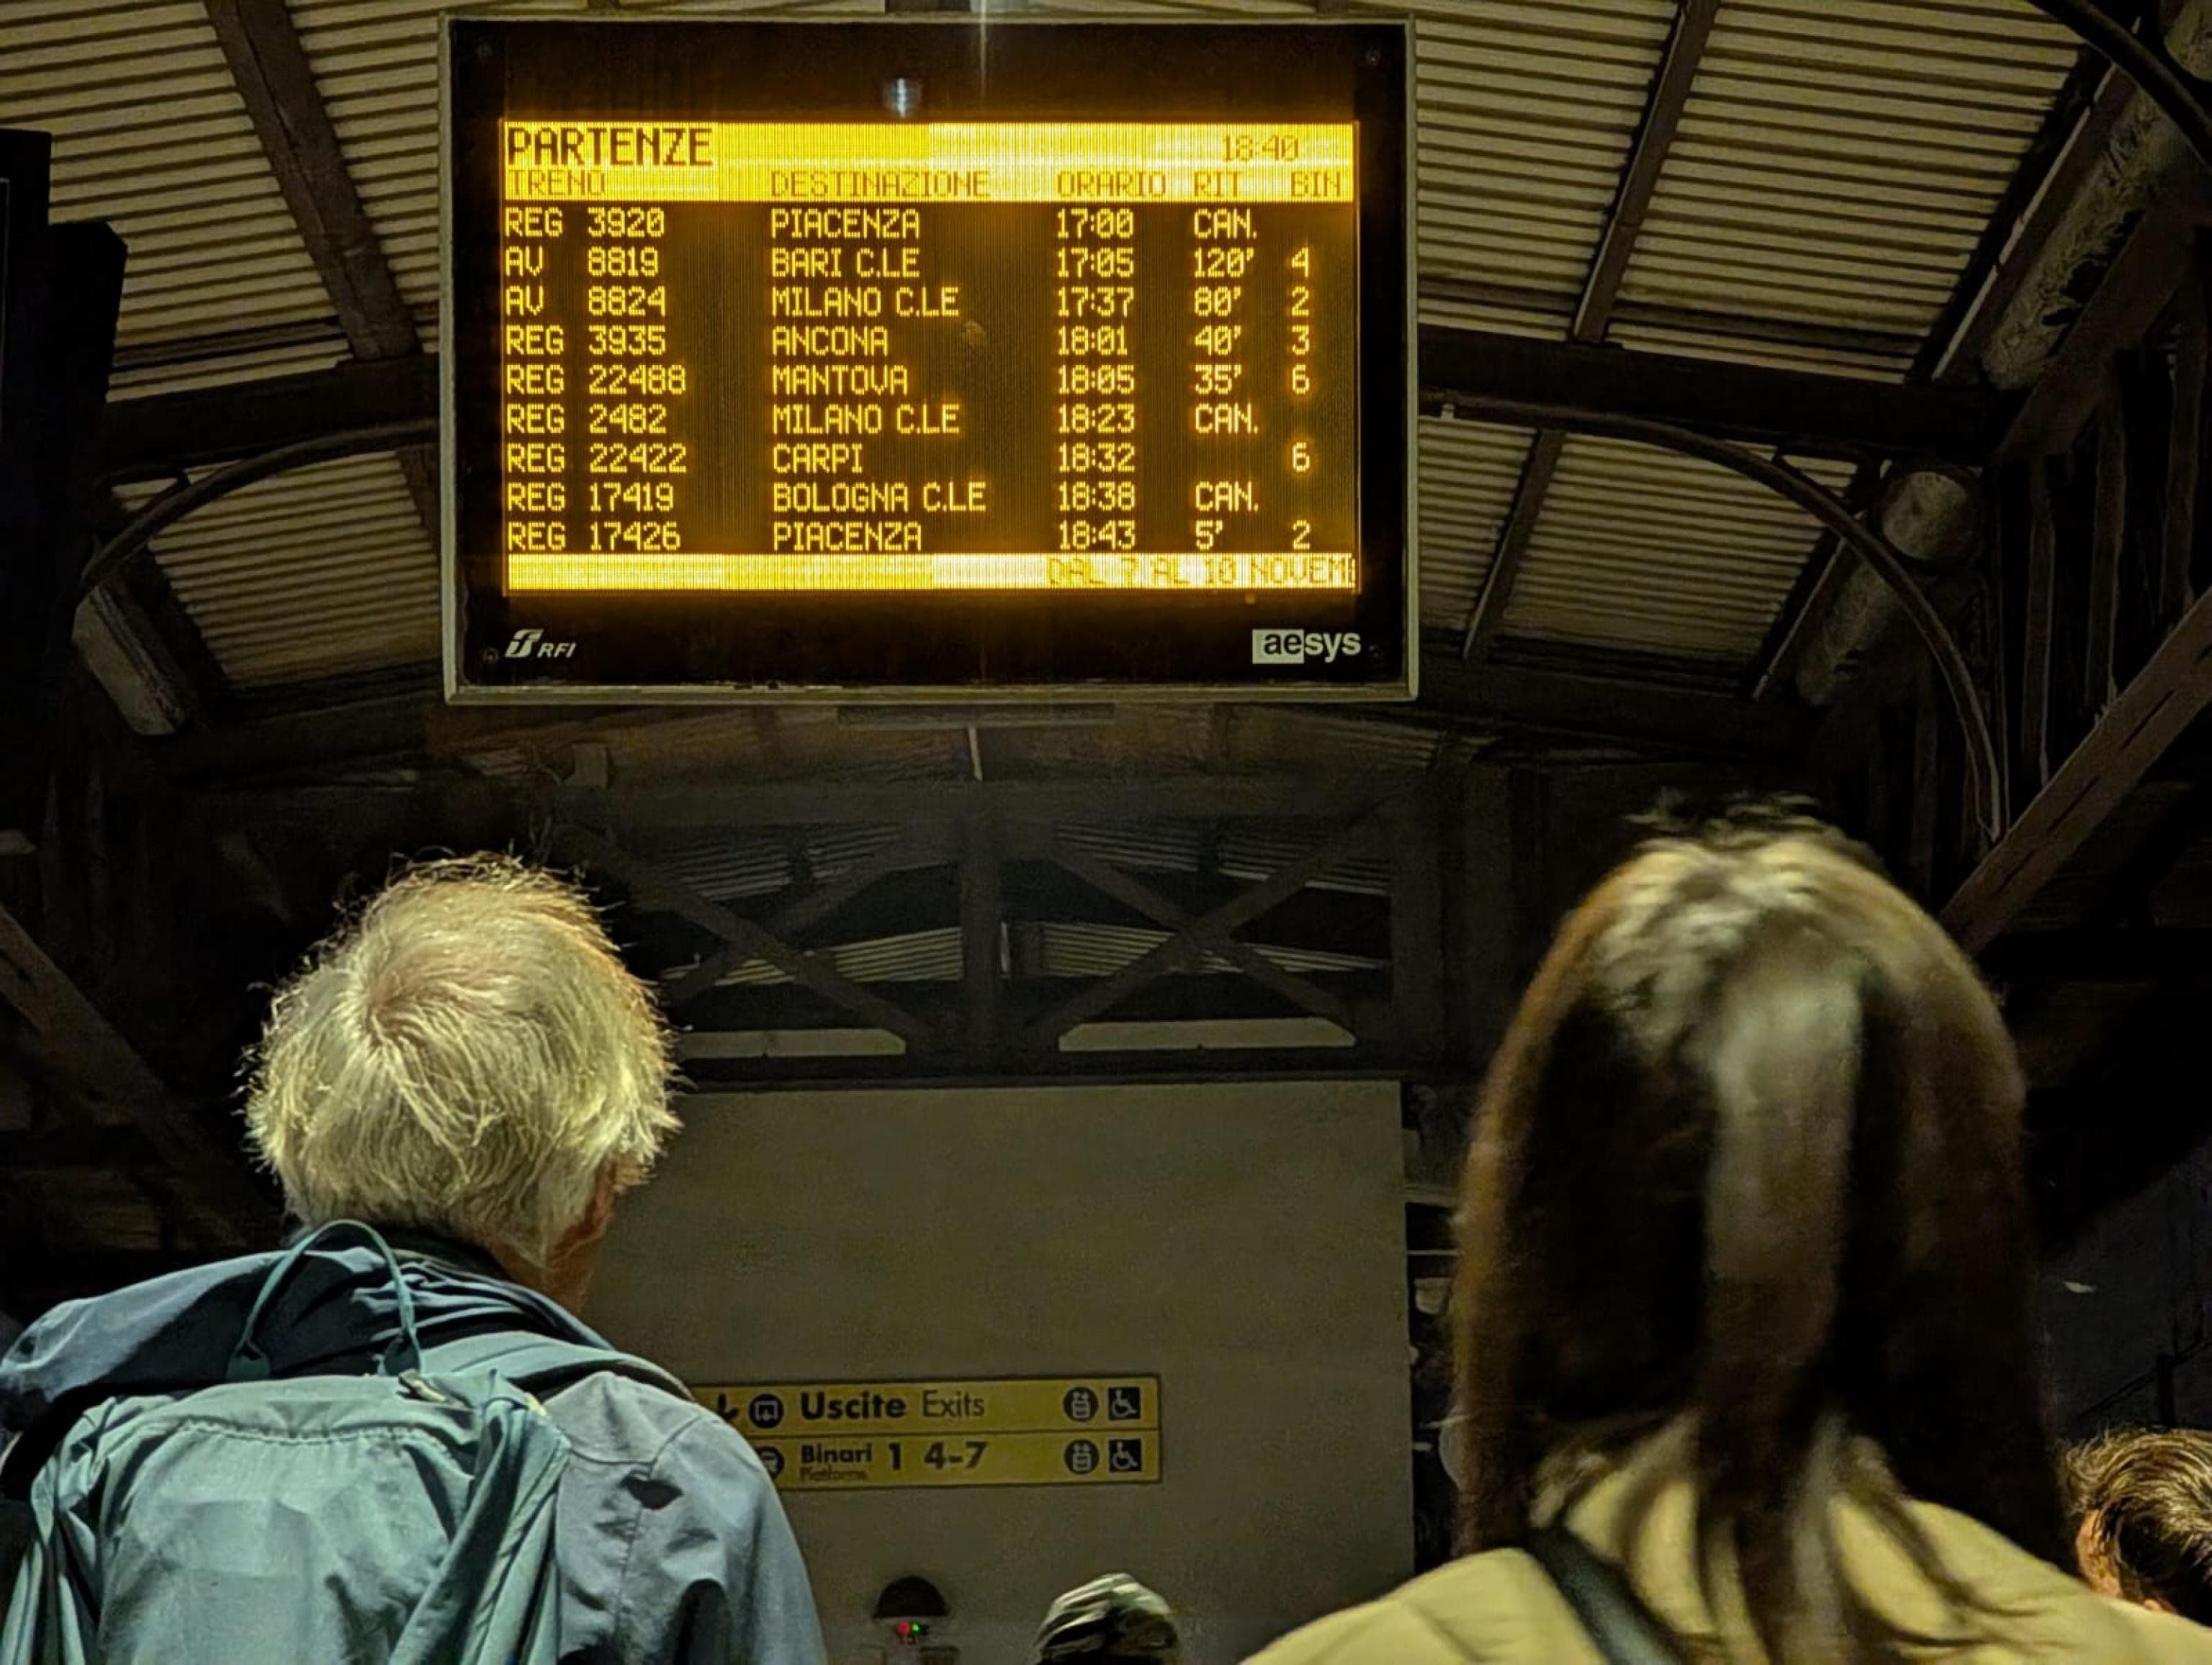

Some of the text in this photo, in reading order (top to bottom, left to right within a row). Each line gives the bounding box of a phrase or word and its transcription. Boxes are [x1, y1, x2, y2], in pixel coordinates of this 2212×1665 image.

[508, 127, 713, 166] PARTENZE
[1224, 135, 1299, 162] 18:40
[508, 169, 1341, 197] TRENO DESTINAZIONE ORARIO RIT BIN
[505, 207, 1256, 238] REG 3920 PIACENZA 17:00 CAN.
[506, 246, 542, 277] AV
[589, 247, 658, 277] 8819
[773, 248, 841, 277] BARI
[857, 248, 919, 277] C.LE
[1058, 248, 1133, 277] 17:05
[1292, 248, 1309, 277] 4
[506, 286, 544, 315] AV
[589, 286, 665, 315] 8824
[773, 287, 881, 317] MILANO
[896, 287, 958, 317] C.LE
[1058, 287, 1133, 317] 17:37
[1292, 287, 1309, 316] 2
[506, 325, 563, 354] REG
[589, 325, 665, 354] 3935
[773, 326, 888, 356] ANCONA
[1058, 326, 1127, 355] 18:01
[1292, 325, 1309, 355] 3
[507, 365, 564, 394] REG
[589, 365, 685, 394] 22488
[773, 365, 907, 395] MANTOVA
[1059, 365, 1134, 394] 18:05
[1292, 364, 1310, 394] 6
[508, 403, 1258, 434] REG 2482 MILANO C.LE 18:23 CAN.
[508, 442, 1310, 473] REG 22422 CARPI 18:32 6
[508, 481, 1258, 511] REG 17419 BOLOGNA C.LE 18:38 CAN.
[508, 521, 565, 551] REG
[590, 521, 680, 551] 17426
[773, 521, 921, 551] PIACENZA
[1060, 520, 1136, 549] 18:43
[1293, 520, 1310, 549] 2
[1050, 557, 1355, 583] DAL 7 AL 10 NOVEM
[536, 642, 576, 658] RFI
[1264, 632, 1361, 663] aesys
[801, 1390, 985, 1420] Uscite Exits
[801, 1442, 872, 1463] Binari
[889, 1442, 902, 1471] 1
